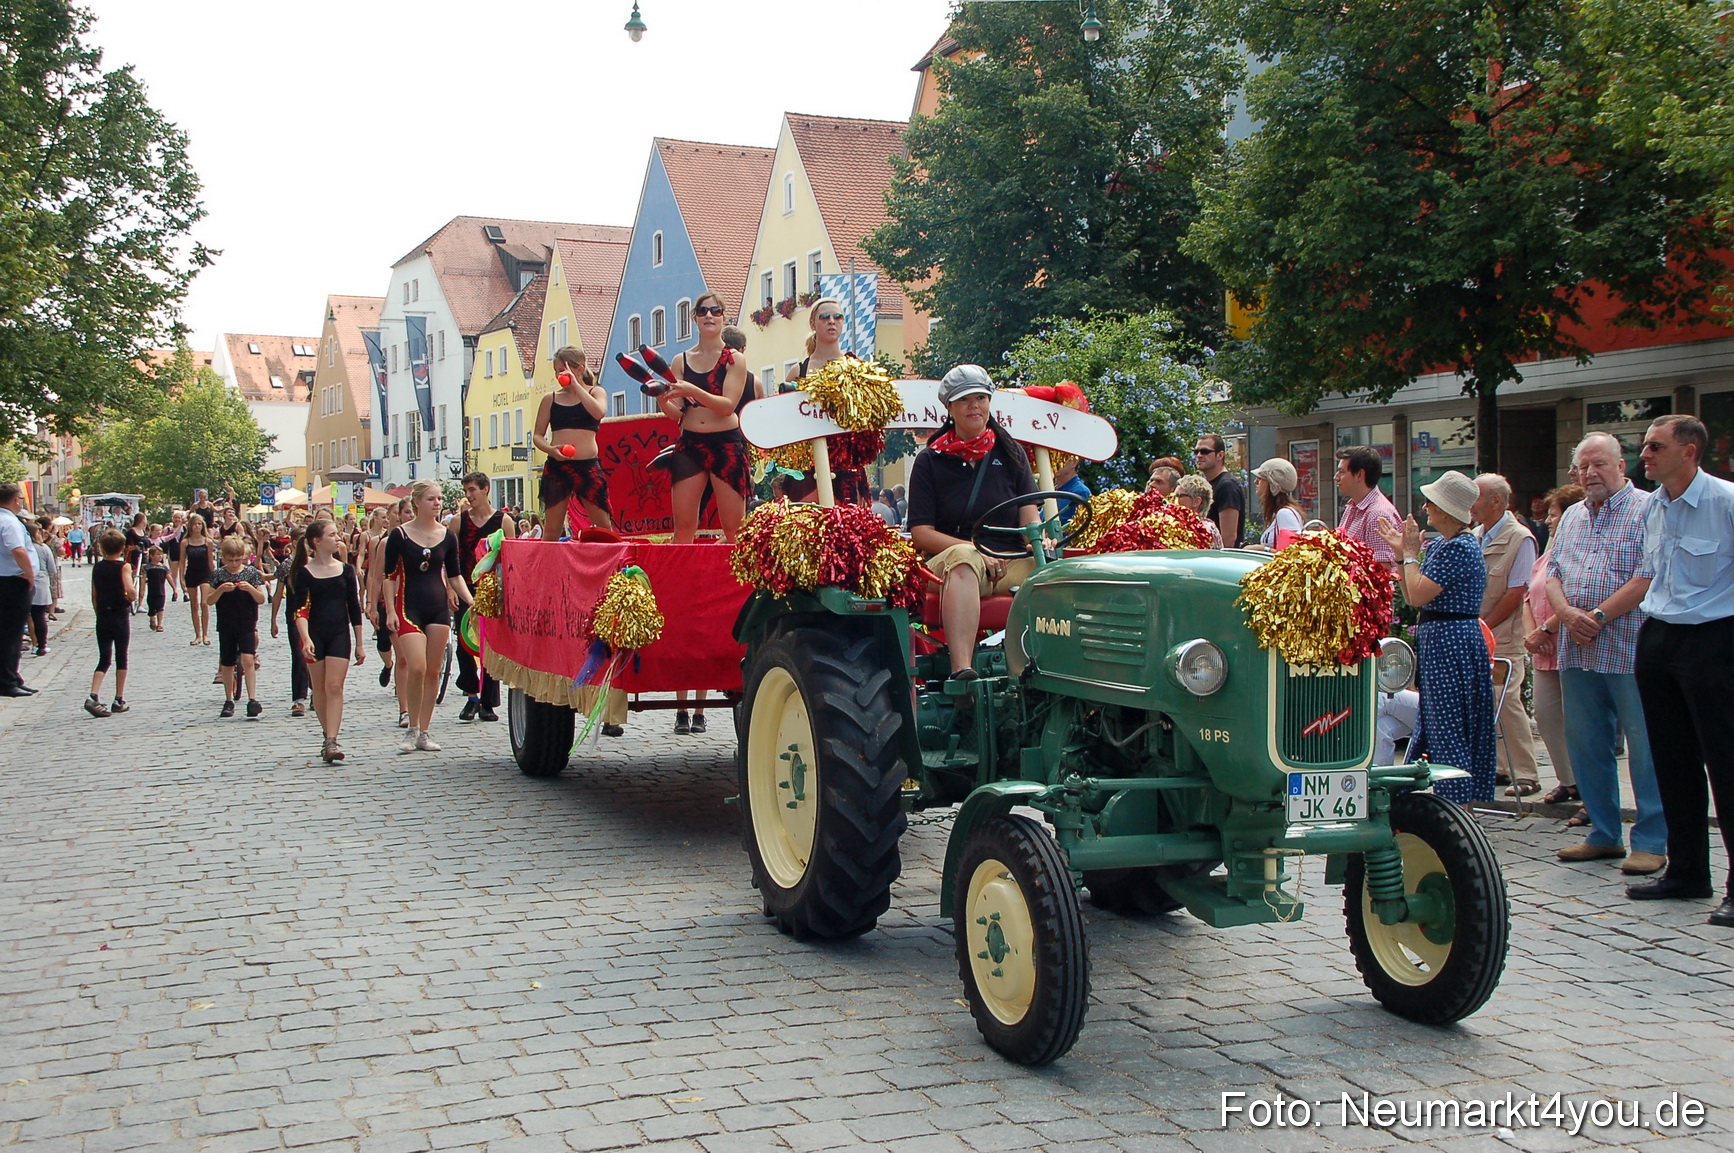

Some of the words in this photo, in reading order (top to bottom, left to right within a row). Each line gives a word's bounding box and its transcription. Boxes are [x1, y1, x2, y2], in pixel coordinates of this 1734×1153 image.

[493, 392, 508, 407] HOTEL
[1031, 412, 1066, 431] e.V.
[1199, 728, 1211, 741] 18
[1214, 729, 1230, 743] PS
[1292, 786, 1299, 794] D
[1304, 775, 1329, 796] NM
[1300, 798, 1325, 818] JK
[1333, 796, 1356, 817] 46
